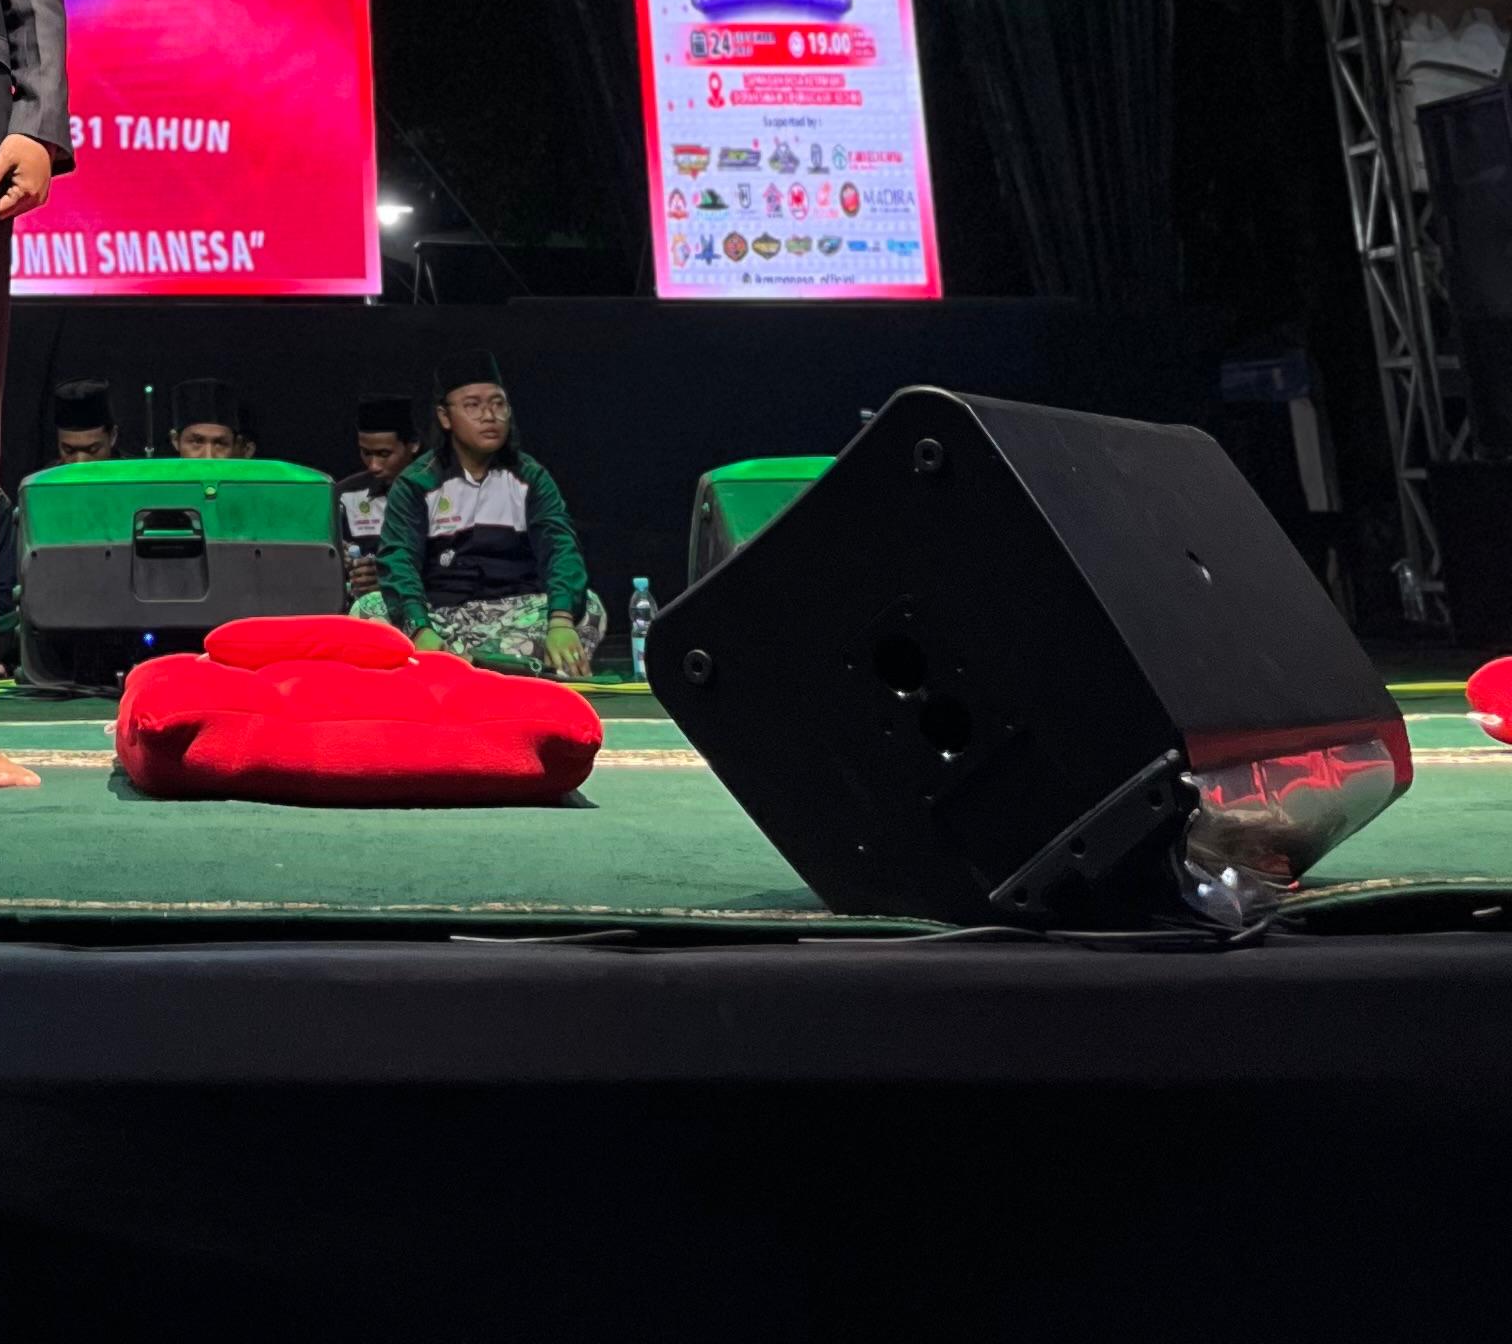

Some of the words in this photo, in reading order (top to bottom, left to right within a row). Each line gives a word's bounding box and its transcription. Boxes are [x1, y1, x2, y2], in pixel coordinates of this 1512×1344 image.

[710, 32, 731, 55] 24
[808, 31, 851, 55] 19.00
[114, 115, 231, 153] TAHUN
[11, 231, 88, 276] UMNI
